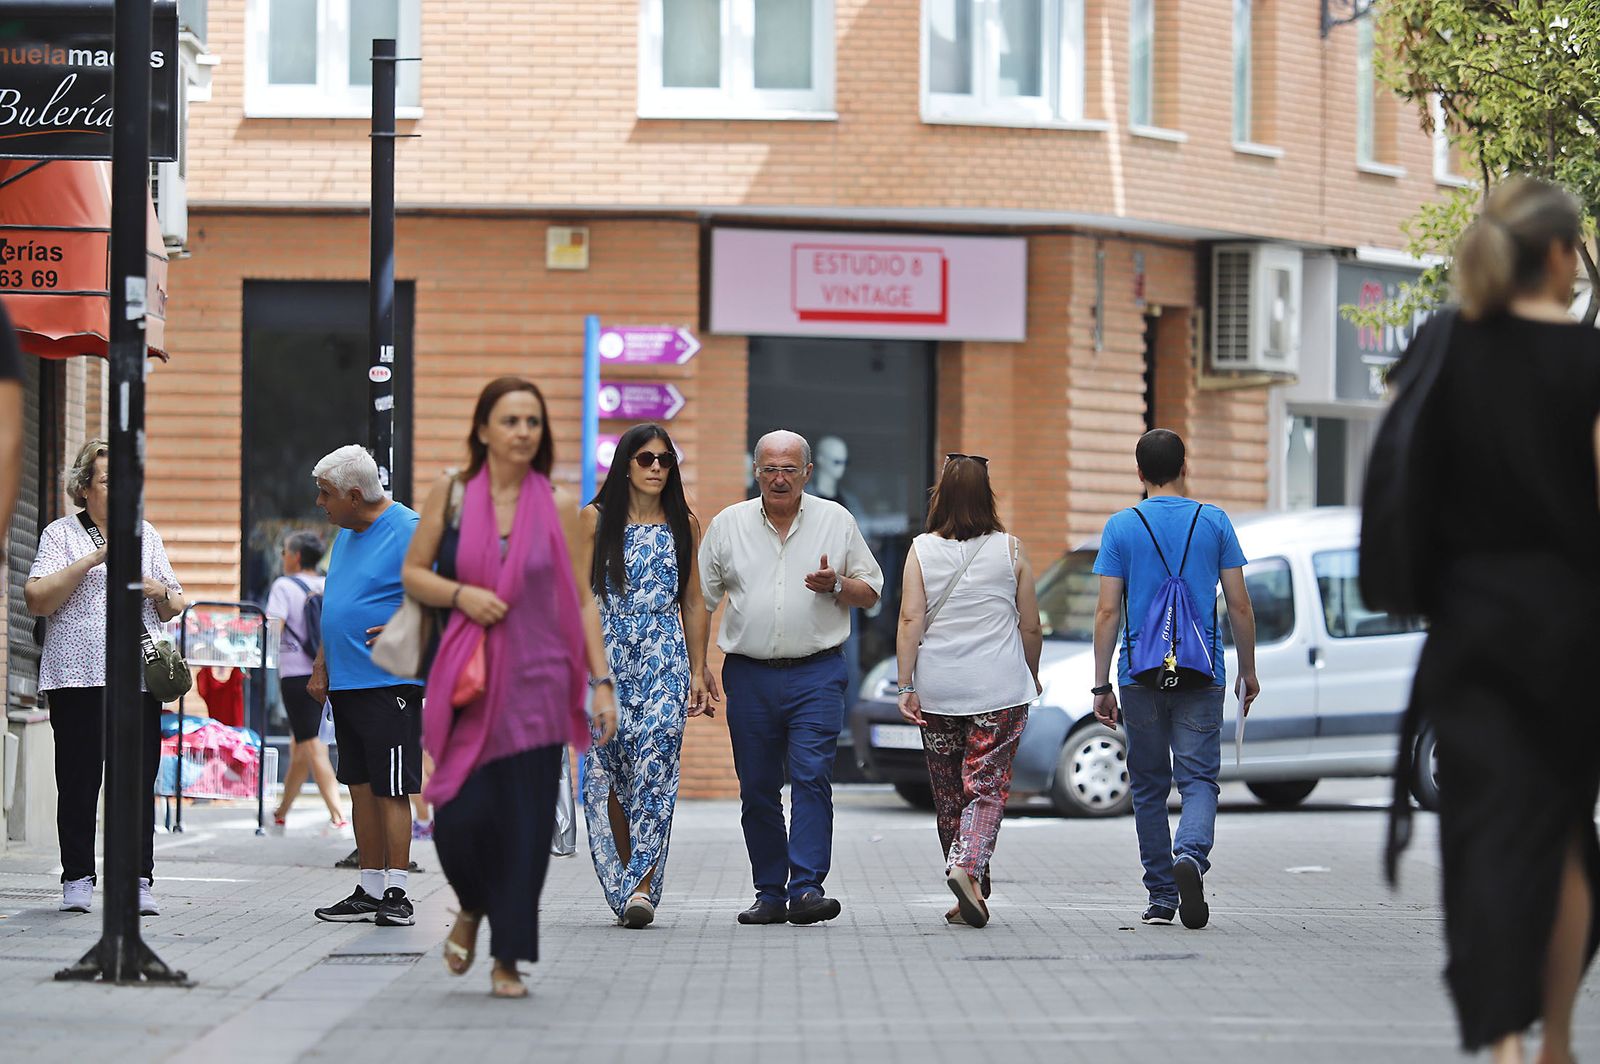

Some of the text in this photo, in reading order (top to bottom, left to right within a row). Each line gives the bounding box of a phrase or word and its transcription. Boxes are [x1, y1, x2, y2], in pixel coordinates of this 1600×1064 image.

[813, 252, 923, 277] ESTUDIO 8
[0, 270, 58, 288] 63 69
[821, 283, 913, 307] VINTAGE
